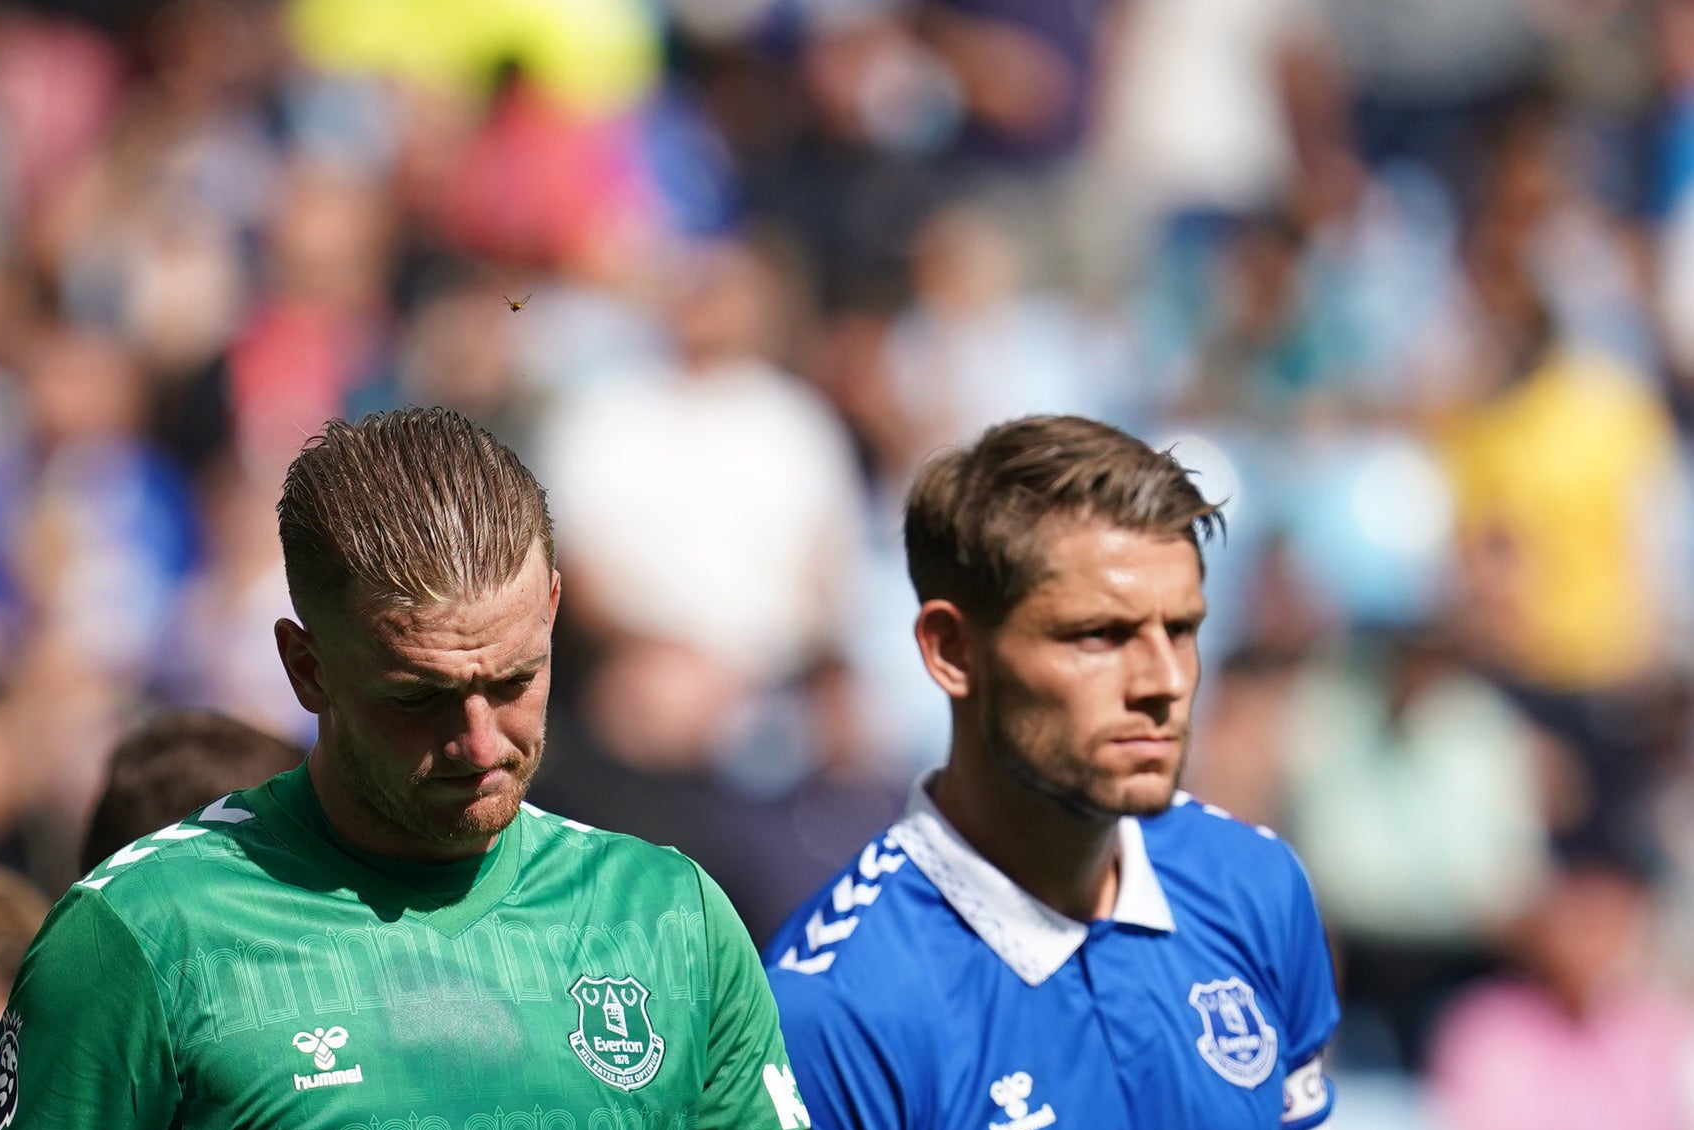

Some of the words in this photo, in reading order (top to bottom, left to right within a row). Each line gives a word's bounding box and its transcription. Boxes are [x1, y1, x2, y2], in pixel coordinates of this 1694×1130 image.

[594, 1036, 643, 1053] Everton
[293, 1064, 364, 1092] hummel
[578, 1049, 593, 1065] NIL
[592, 1062, 616, 1081] SATIS
[617, 1075, 635, 1085] NISI
[634, 1052, 659, 1082] OPTIMUM
